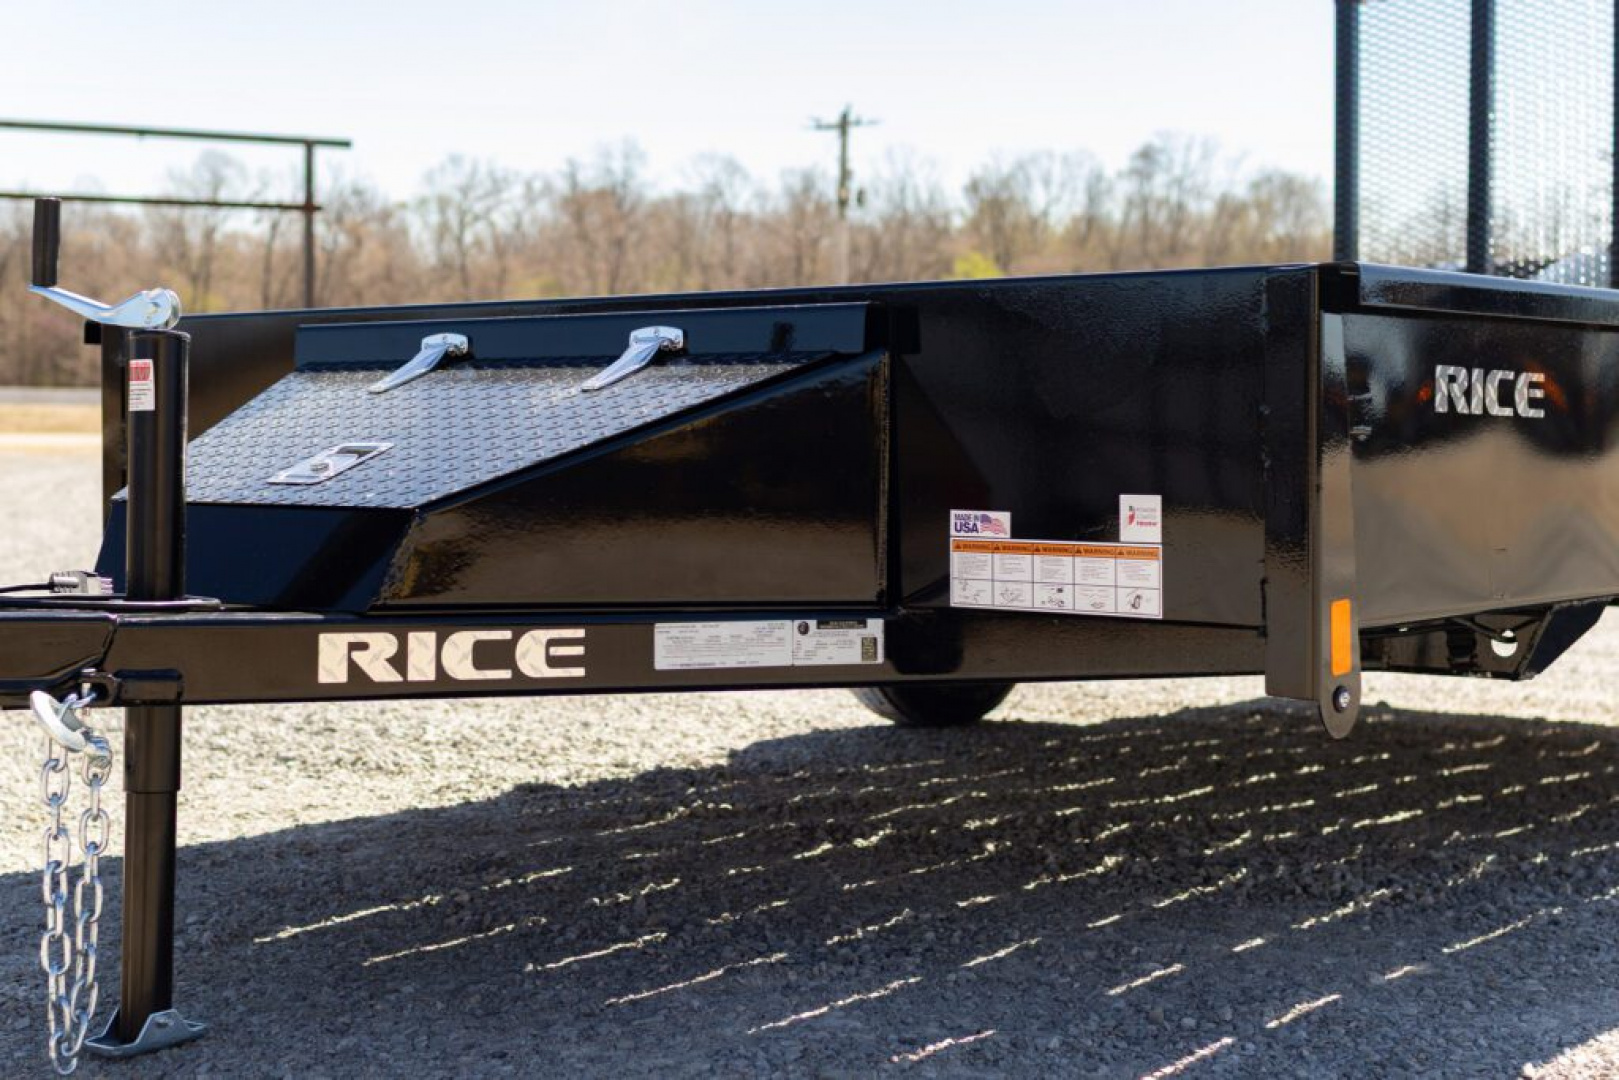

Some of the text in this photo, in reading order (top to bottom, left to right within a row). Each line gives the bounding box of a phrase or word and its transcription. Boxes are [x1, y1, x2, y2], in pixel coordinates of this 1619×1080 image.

[1434, 364, 1546, 418] RICE
[954, 513, 972, 521] MADE
[954, 522, 979, 533] USA
[962, 543, 991, 551] WARNING
[1001, 544, 1031, 552] WARNING
[1042, 545, 1073, 553] WARNING
[1083, 547, 1115, 556] WARNING
[1125, 549, 1158, 557] WARNING
[318, 628, 586, 684] RICE
